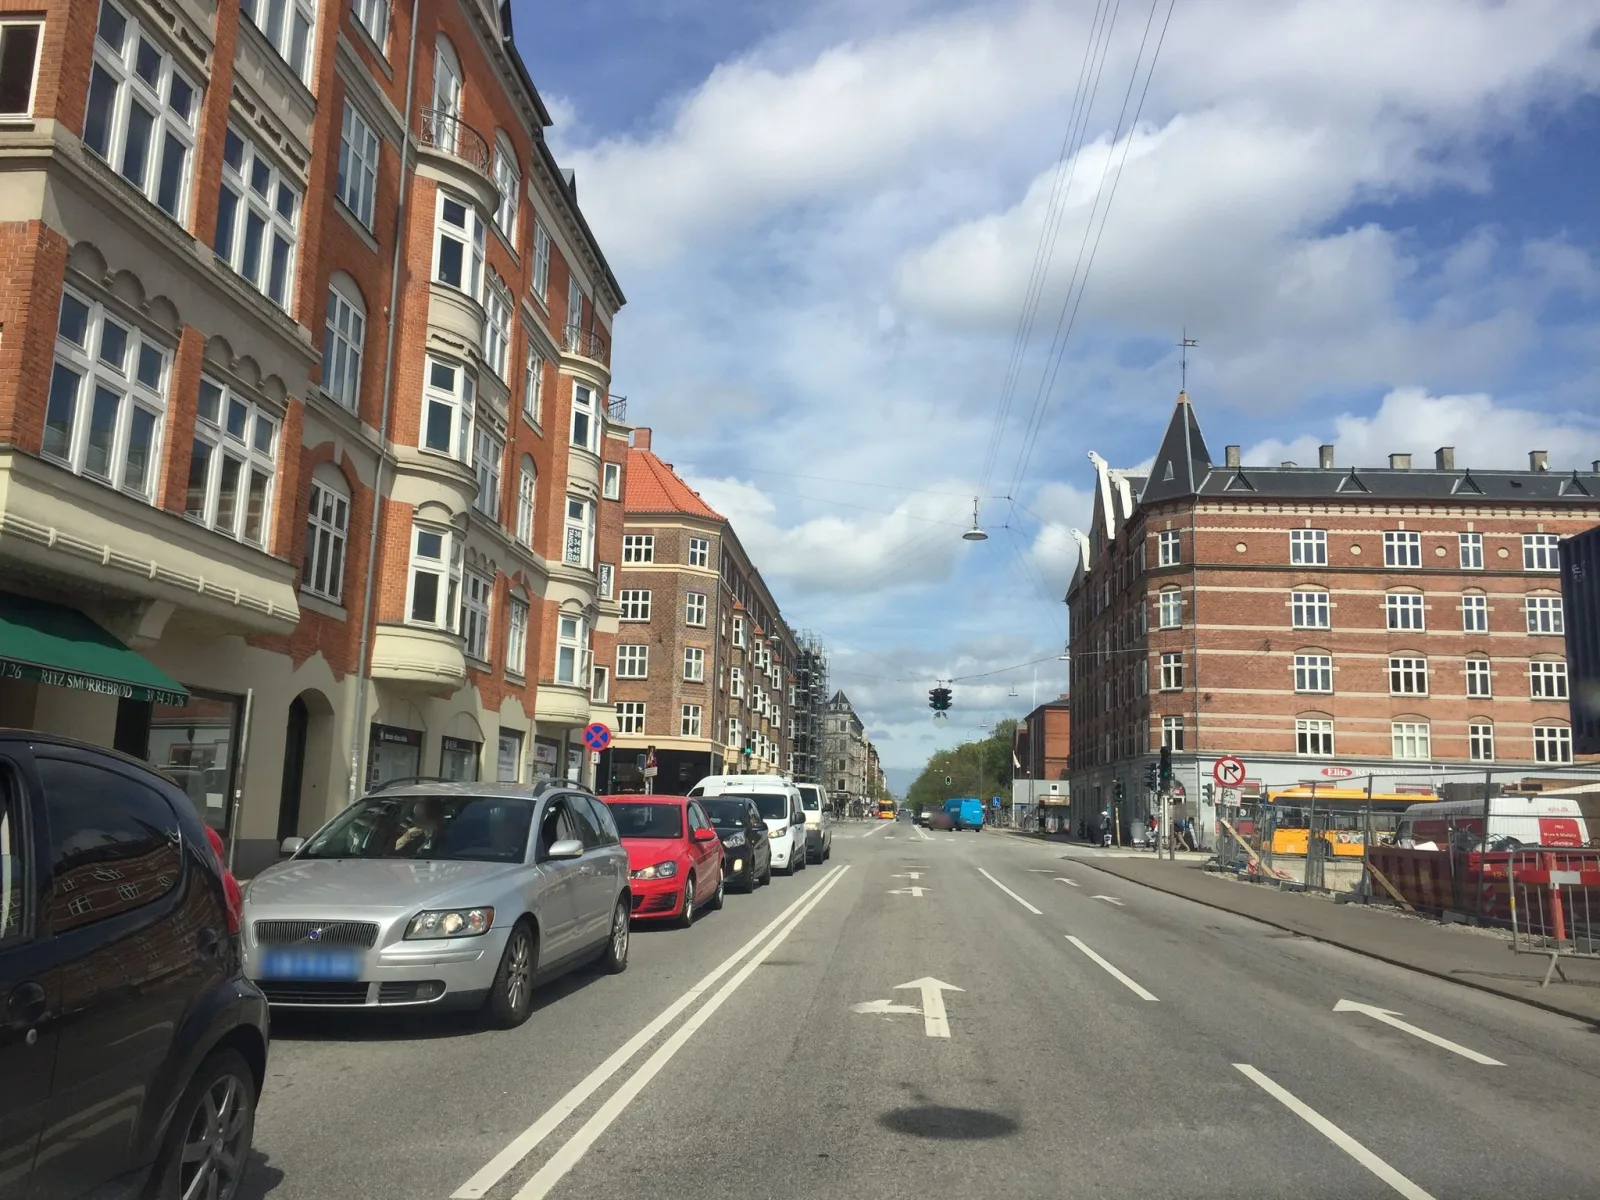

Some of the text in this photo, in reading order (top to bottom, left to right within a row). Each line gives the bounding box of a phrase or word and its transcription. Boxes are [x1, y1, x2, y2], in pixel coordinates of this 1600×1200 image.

[574, 530, 581, 538] 38
[7, 663, 22, 679] 26
[40, 669, 65, 686] RITZ
[144, 689, 155, 702] 38
[155, 691, 165, 704] 34
[165, 693, 174, 706] 31
[174, 695, 184, 707] 26
[1327, 768, 1348, 776] Elite
